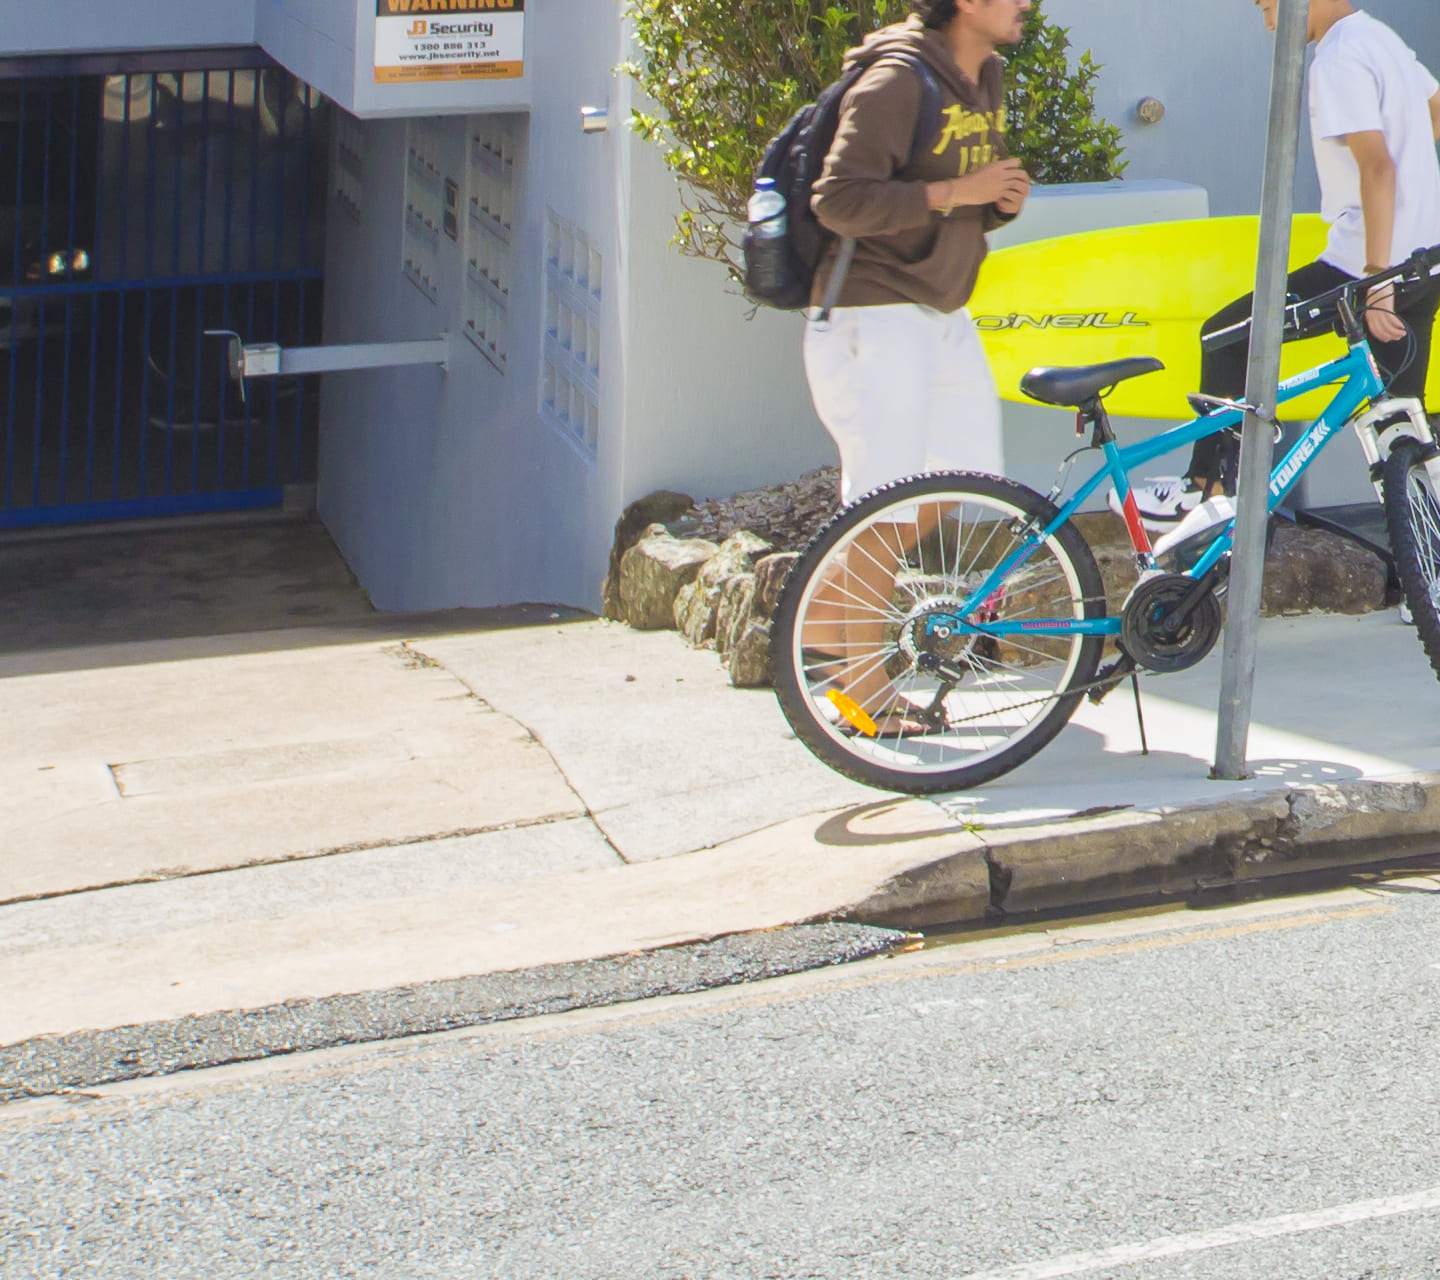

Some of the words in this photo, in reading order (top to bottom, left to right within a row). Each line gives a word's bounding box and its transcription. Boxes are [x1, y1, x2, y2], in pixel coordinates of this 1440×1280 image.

[430, 20, 493, 37] Security
[972, 311, 1151, 331] O'NEILL
[1269, 424, 1325, 497] TOUREX
